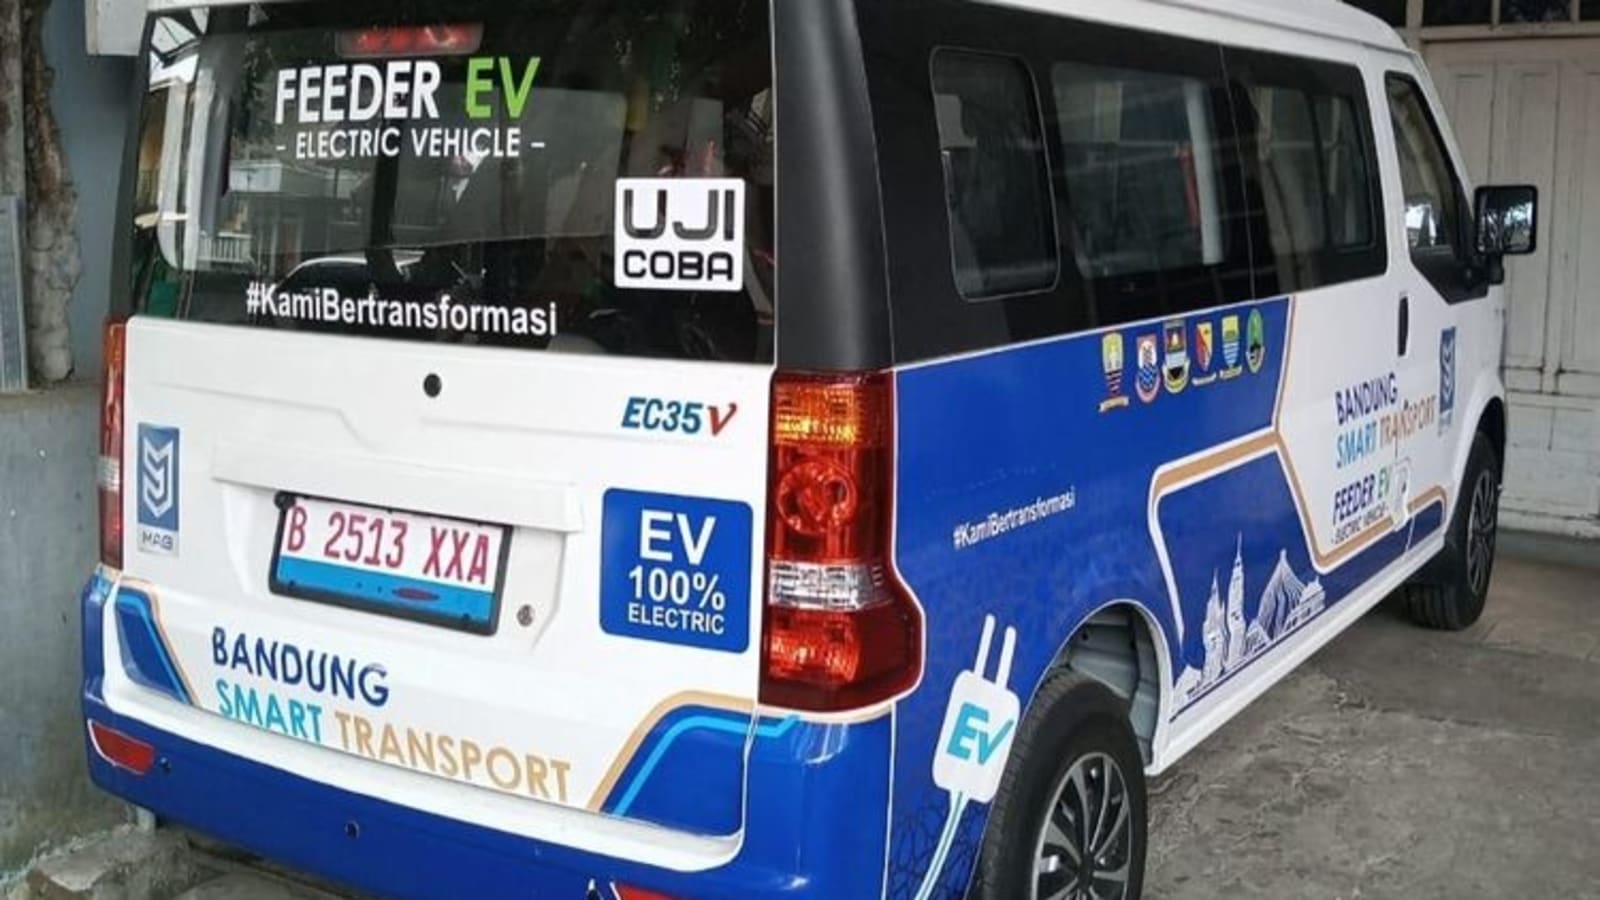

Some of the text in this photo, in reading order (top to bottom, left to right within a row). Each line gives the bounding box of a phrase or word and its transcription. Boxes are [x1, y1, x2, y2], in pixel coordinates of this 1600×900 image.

[274, 56, 541, 127] FEEDER EV
[295, 126, 521, 160] ELECTRIC VEHICLE
[622, 188, 736, 241] UJI
[623, 249, 734, 282] COBA
[246, 281, 558, 337] #KamiBertransformasi
[1335, 372, 1398, 425] BANDUNG
[1336, 420, 1377, 468] SMART
[1380, 395, 1436, 448] TRANSPORT
[953, 485, 1077, 551] #KamiBertransformasi
[1333, 474, 1375, 525] FEEDER
[287, 505, 490, 585] B 2513 XXA
[640, 508, 717, 566] EV
[628, 565, 726, 611] 100%
[628, 603, 725, 636] ELECTRIC
[211, 626, 390, 708] BANDUNG
[215, 678, 571, 802] SMART TRANSPORT
